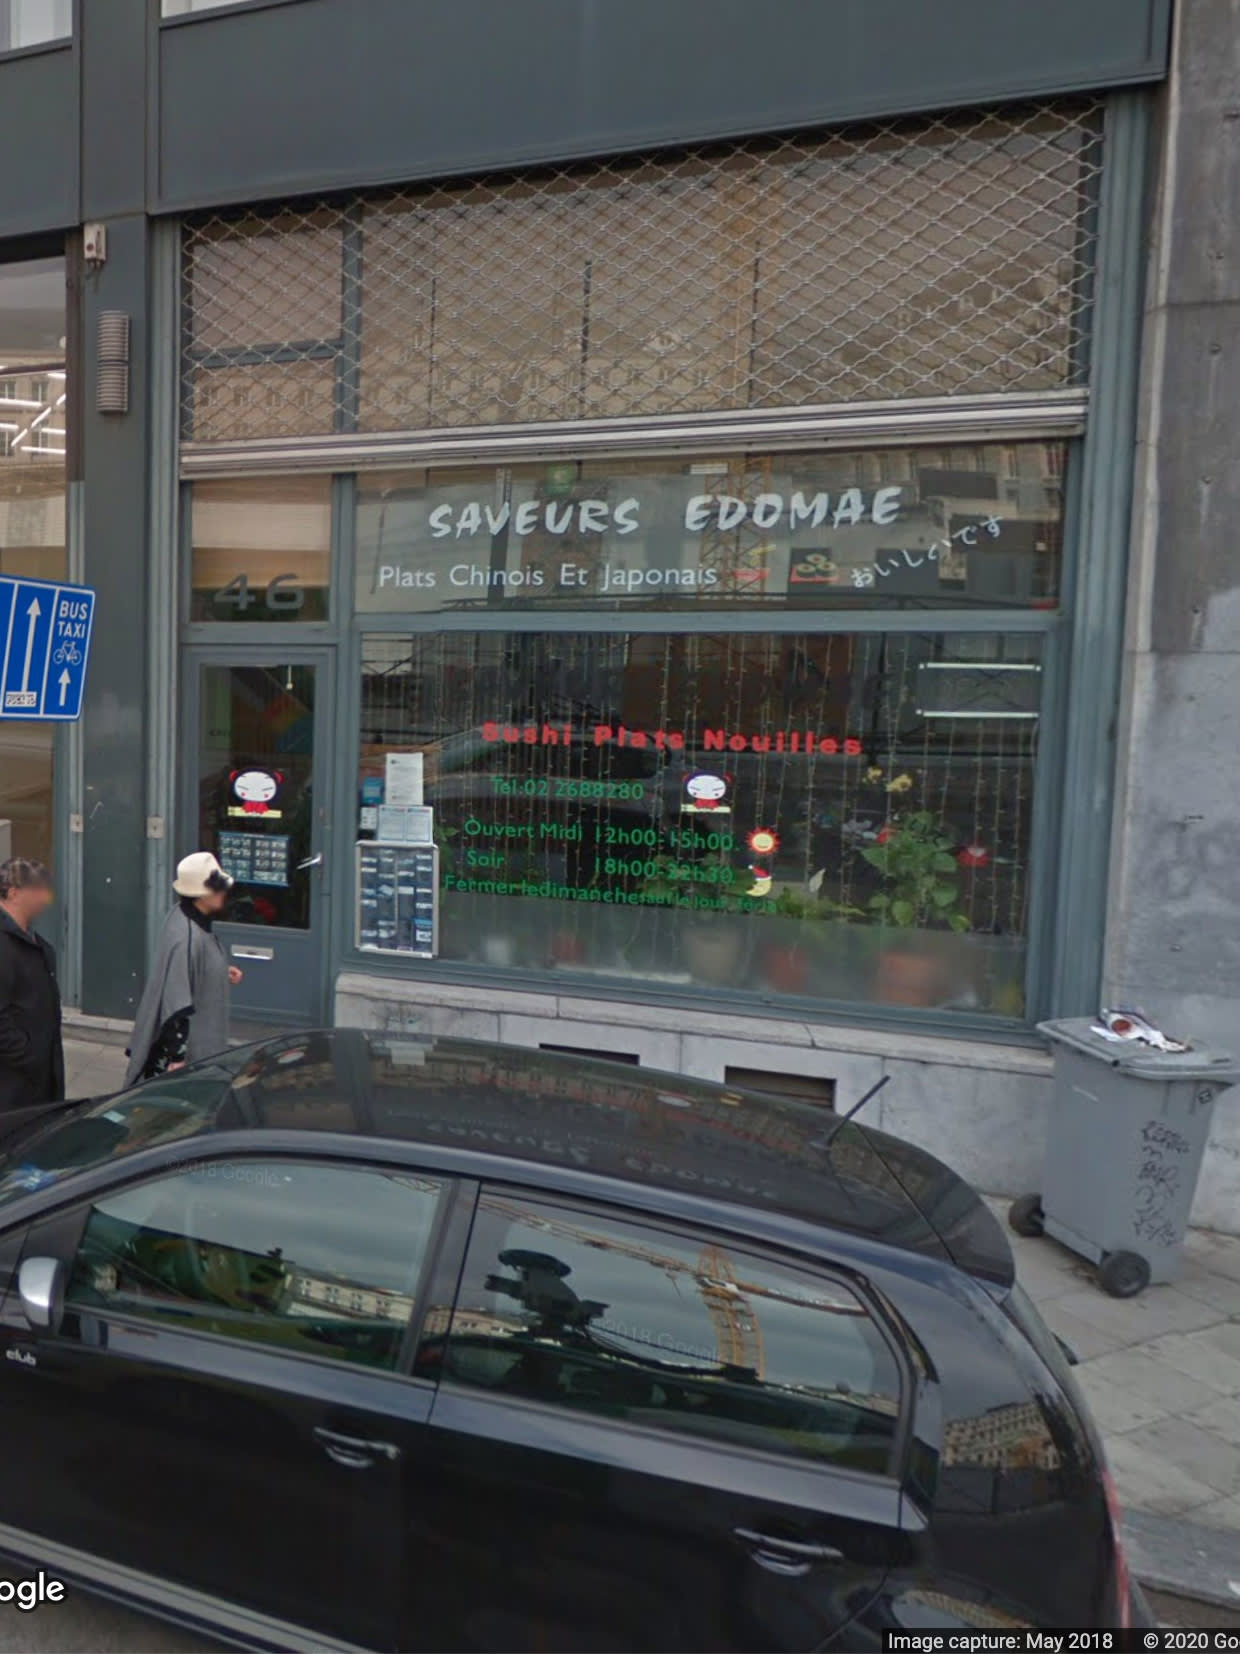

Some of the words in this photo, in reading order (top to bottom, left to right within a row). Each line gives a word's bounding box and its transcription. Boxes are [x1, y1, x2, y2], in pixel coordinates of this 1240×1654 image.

[428, 497, 640, 539] SAVEURS
[684, 486, 903, 532] EDOMAE
[378, 565, 436, 588] Plats
[449, 563, 544, 587] Chinois
[560, 562, 589, 586] Et
[599, 563, 718, 592] Japonais
[213, 573, 304, 610] 46
[59, 600, 89, 620] BUS
[57, 620, 86, 639] TAXI
[481, 721, 572, 746] Sushi
[593, 724, 684, 750] Plats
[703, 728, 863, 757] Nouilles
[554, 780, 645, 800] 2688280
[464, 819, 535, 839] Ouvert
[540, 823, 583, 841] Midi
[466, 849, 505, 868] Soir
[444, 874, 518, 895] Fermer
